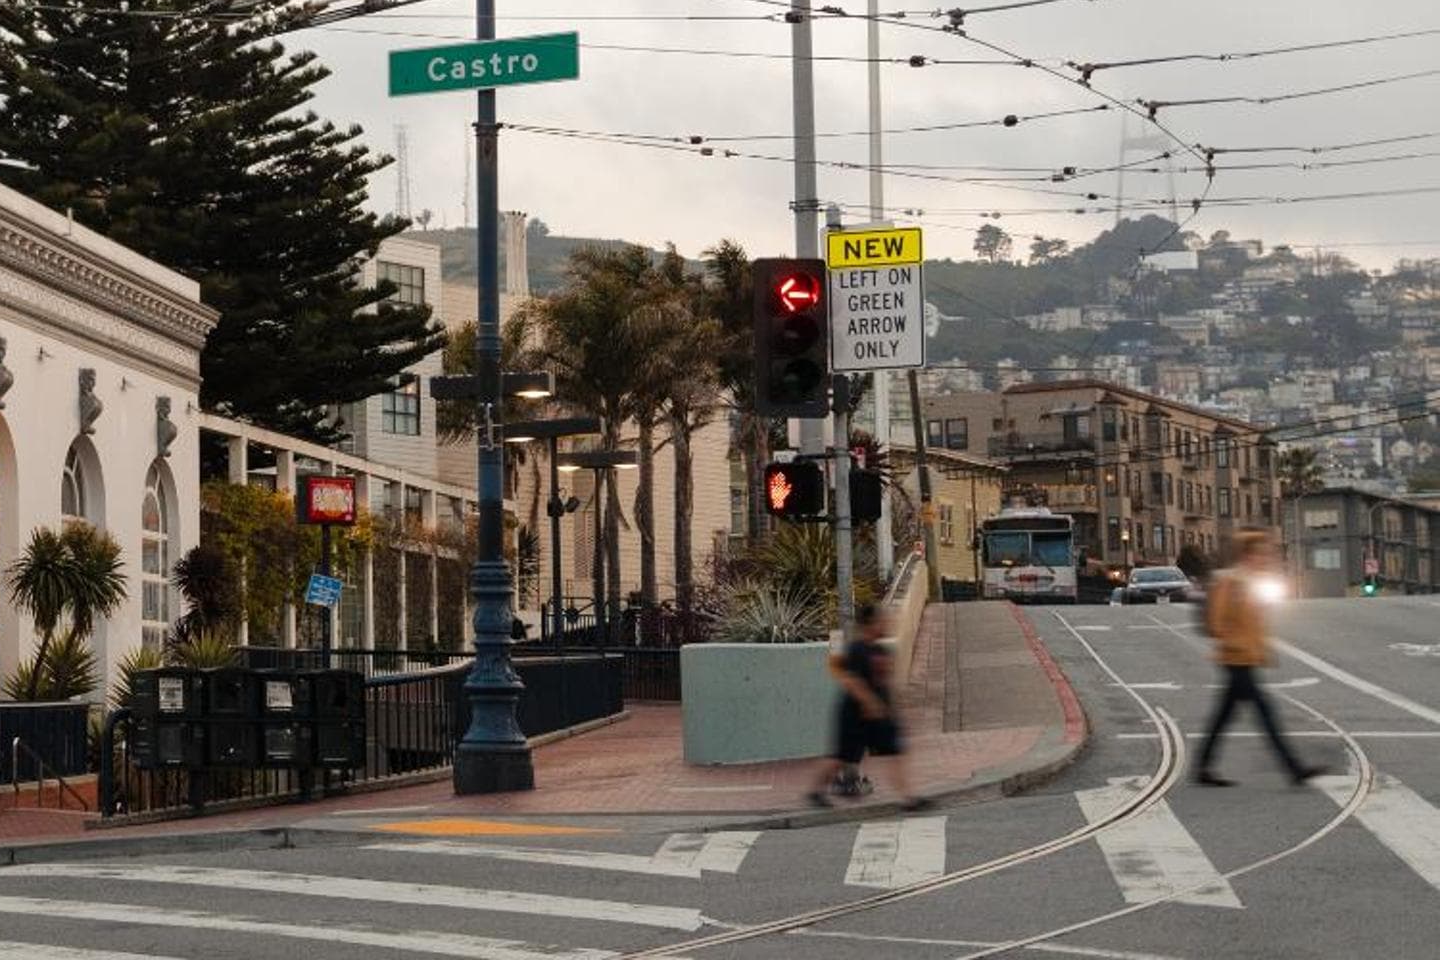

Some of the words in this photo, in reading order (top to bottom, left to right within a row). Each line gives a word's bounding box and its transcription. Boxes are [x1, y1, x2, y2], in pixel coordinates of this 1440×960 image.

[427, 52, 539, 82] Castro
[843, 236, 905, 260] NEW
[839, 269, 878, 290] LEFT
[888, 267, 913, 285] ON
[847, 292, 905, 312] GREEN
[847, 316, 907, 336] ARROW
[853, 341, 900, 360] ONLY
